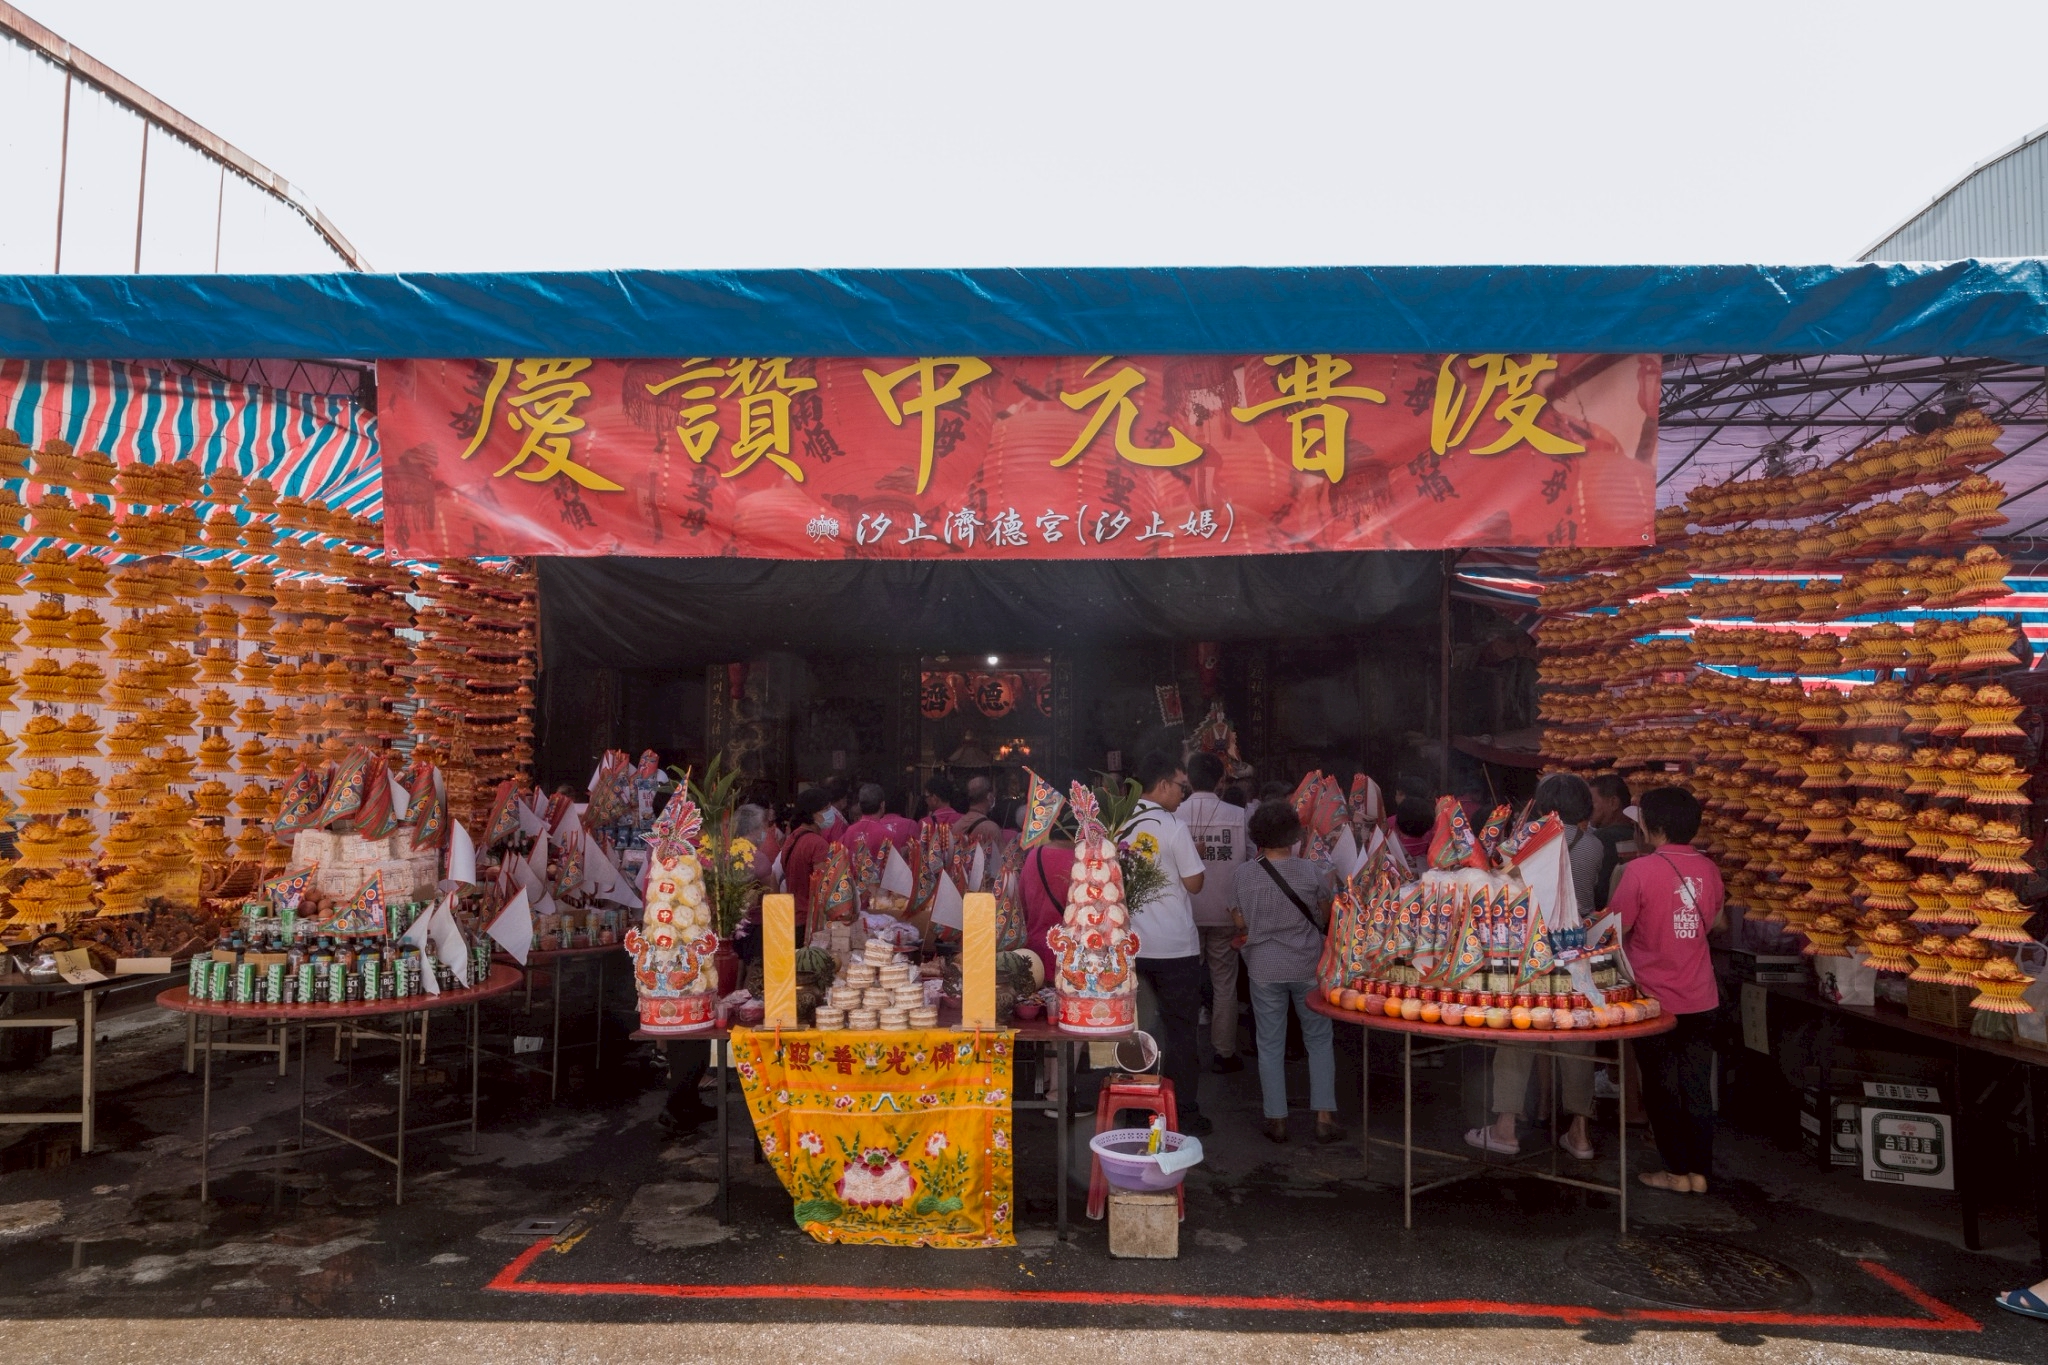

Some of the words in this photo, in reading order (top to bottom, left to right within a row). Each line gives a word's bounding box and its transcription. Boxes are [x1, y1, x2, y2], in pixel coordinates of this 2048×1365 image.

[1673, 914, 1700, 923] MAZU
[1673, 922, 1699, 930] BLESS
[1674, 929, 1697, 939] YOU
